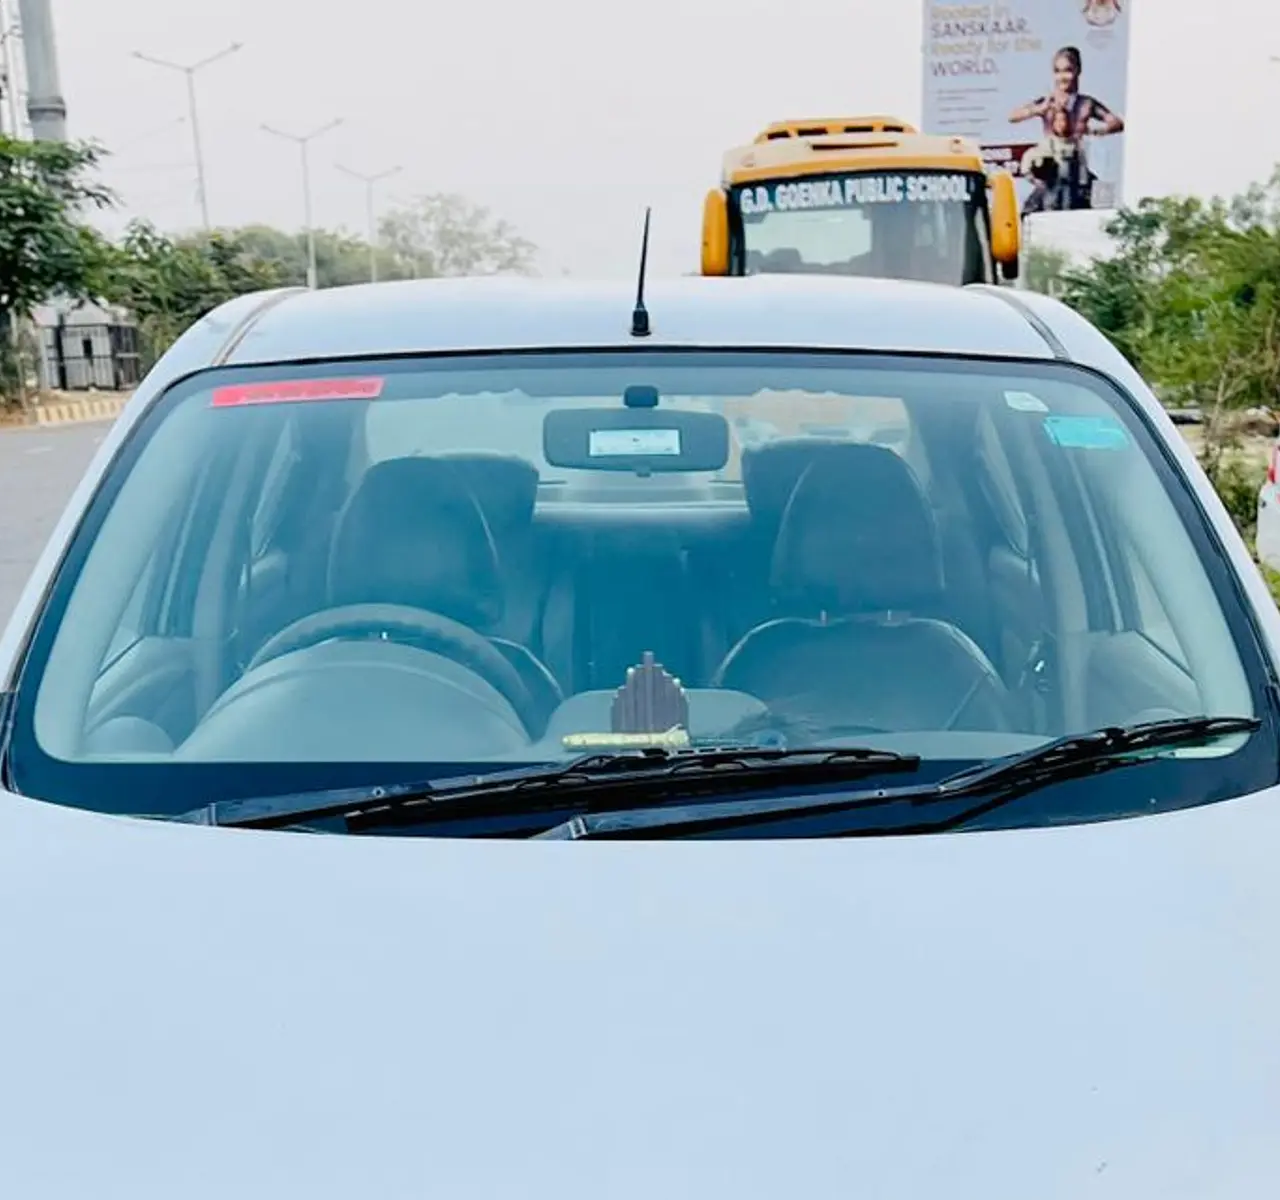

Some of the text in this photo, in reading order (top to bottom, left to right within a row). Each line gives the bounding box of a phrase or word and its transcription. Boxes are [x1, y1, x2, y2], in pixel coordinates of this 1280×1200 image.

[775, 180, 843, 210] GOENKA
[844, 176, 903, 204] PUBLIC
[906, 174, 971, 202] SCHOOL
